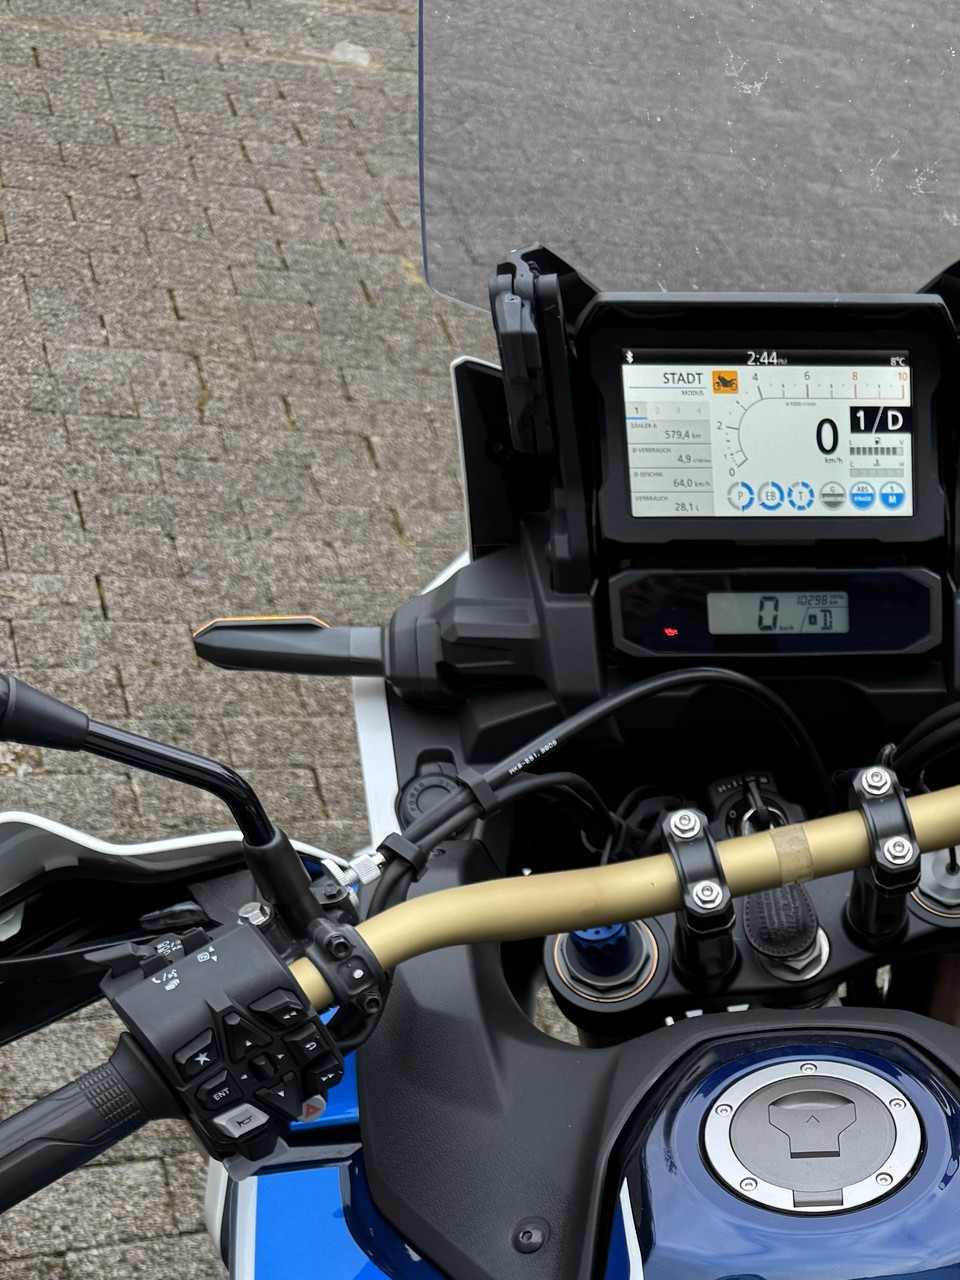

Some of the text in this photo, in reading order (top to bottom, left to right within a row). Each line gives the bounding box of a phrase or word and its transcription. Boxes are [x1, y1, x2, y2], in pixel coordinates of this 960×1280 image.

[747, 351, 778, 365] 2:44
[663, 372, 704, 385] STADT
[752, 373, 759, 381] 4
[804, 371, 811, 381] 6
[851, 371, 858, 381] 8
[898, 371, 908, 381] 10
[716, 421, 723, 431] 2
[664, 430, 690, 441] 579,4
[816, 418, 839, 455] 0
[677, 454, 692, 464] 4,9
[729, 468, 736, 477] 0
[673, 478, 693, 489] 64,0
[737, 491, 743, 500] P
[765, 491, 777, 501] EB
[798, 491, 803, 501] T
[675, 502, 694, 513] 28,1
[758, 596, 779, 631] 0
[213, 1087, 231, 1101] ENT
